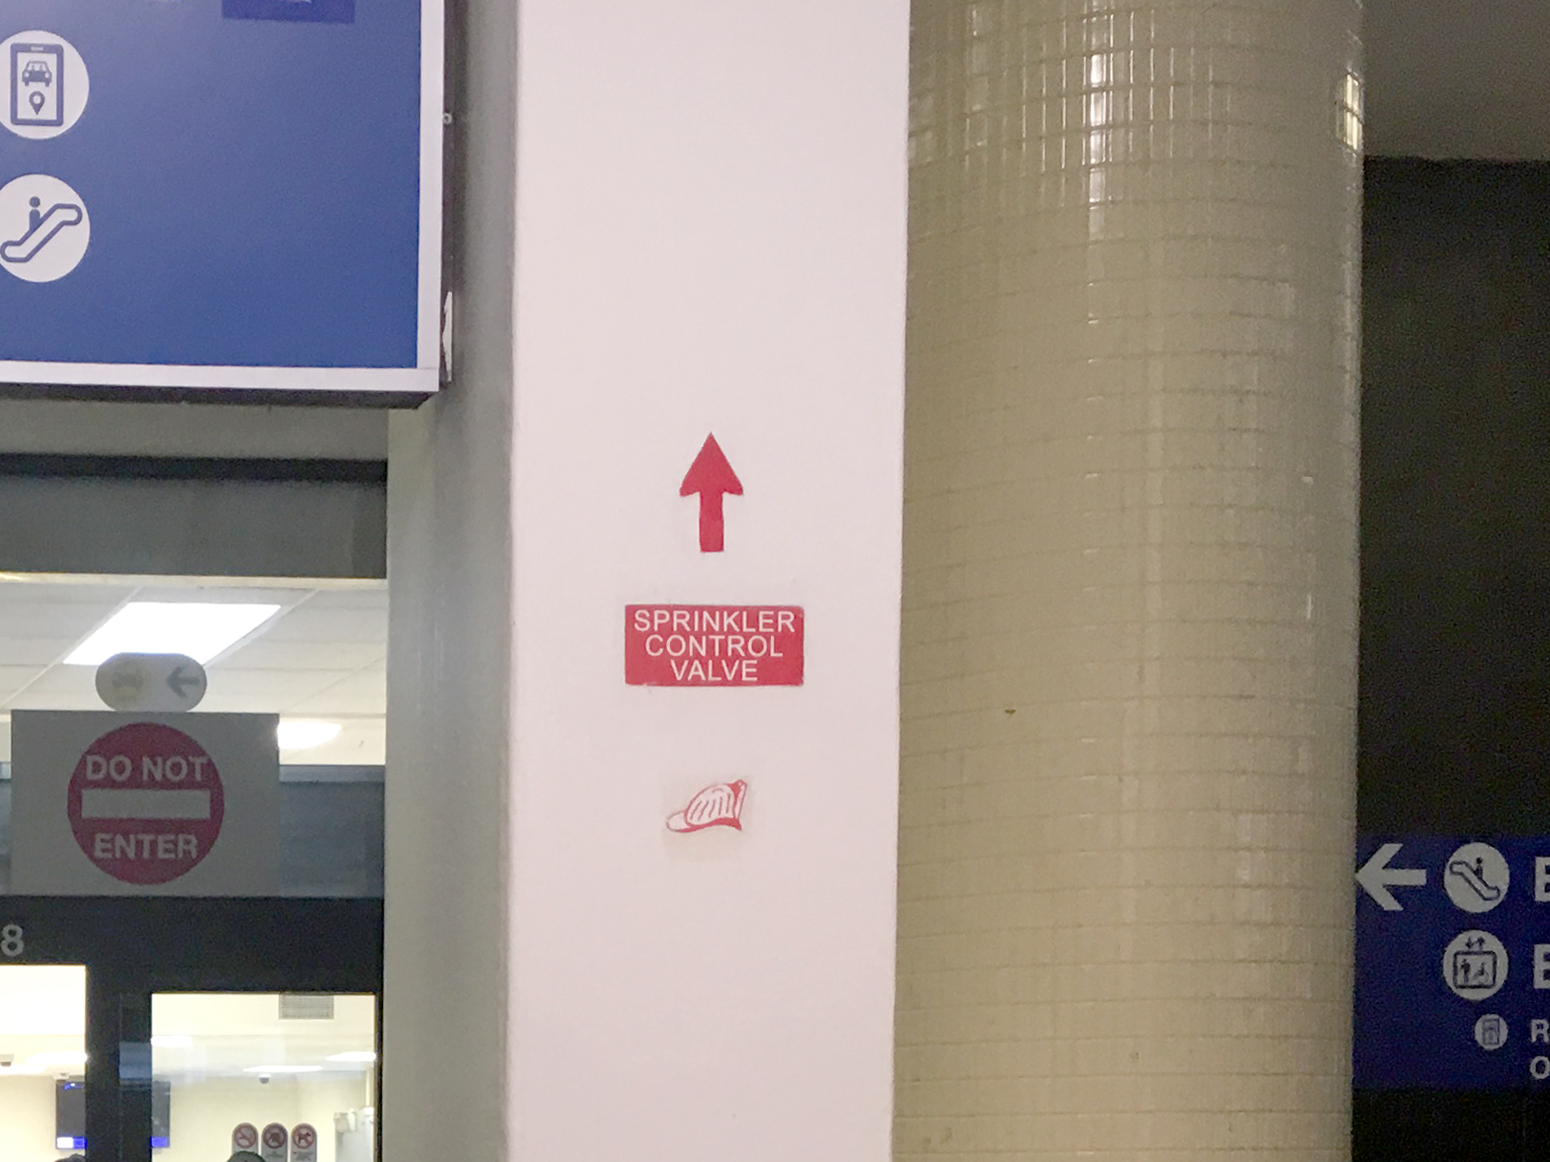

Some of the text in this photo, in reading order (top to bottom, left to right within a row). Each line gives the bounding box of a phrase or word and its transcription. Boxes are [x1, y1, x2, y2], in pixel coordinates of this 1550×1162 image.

[634, 610, 795, 632] SPRINKLER
[645, 634, 783, 657] CONTROL
[670, 659, 758, 681] VALVE
[85, 755, 207, 782] DO NOT
[94, 832, 198, 860] ENTER
